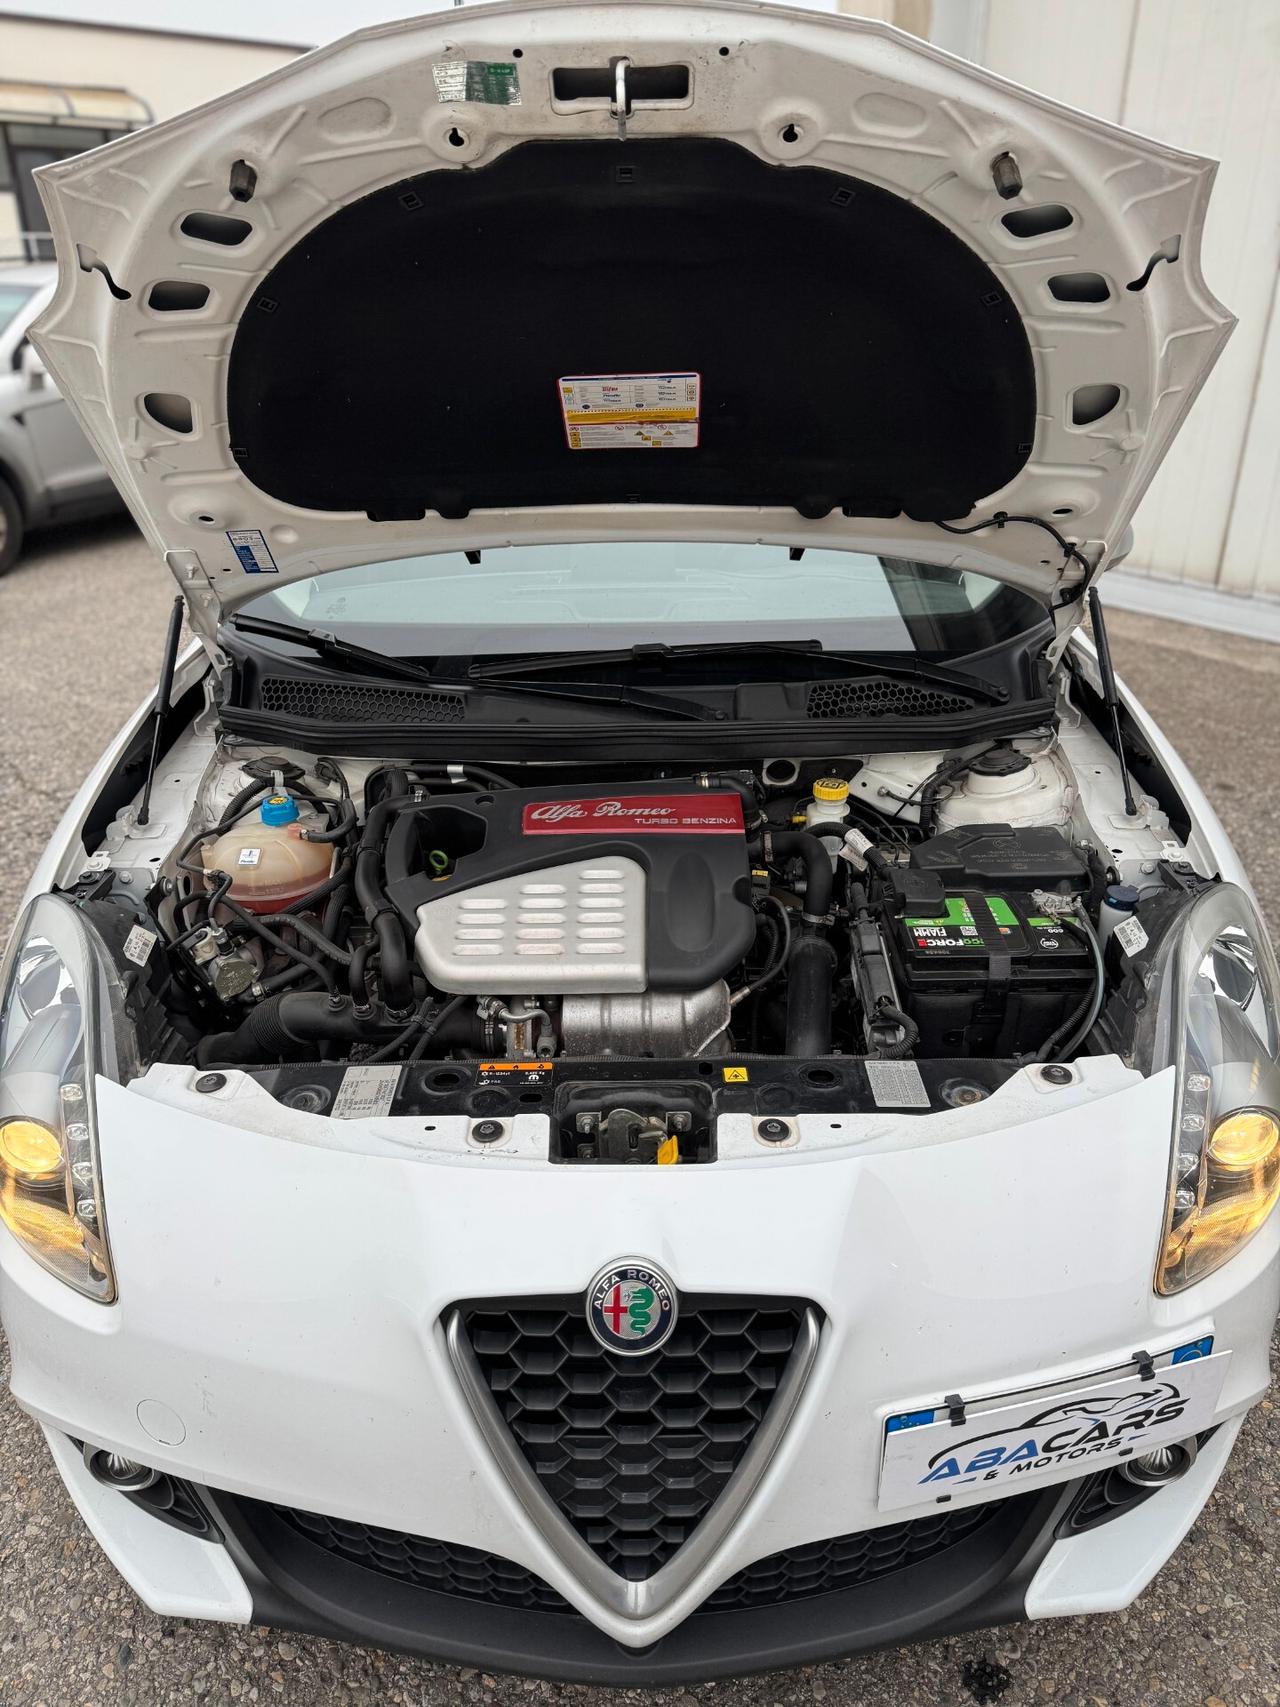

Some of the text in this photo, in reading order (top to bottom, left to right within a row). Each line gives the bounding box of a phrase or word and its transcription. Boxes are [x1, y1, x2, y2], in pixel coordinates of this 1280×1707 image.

[531, 801, 676, 822] Alfa Romeo
[914, 927, 947, 937] FIAMM
[594, 1269, 670, 1311] ALFA ROMEO
[983, 1437, 1122, 1481] & MOTORS
